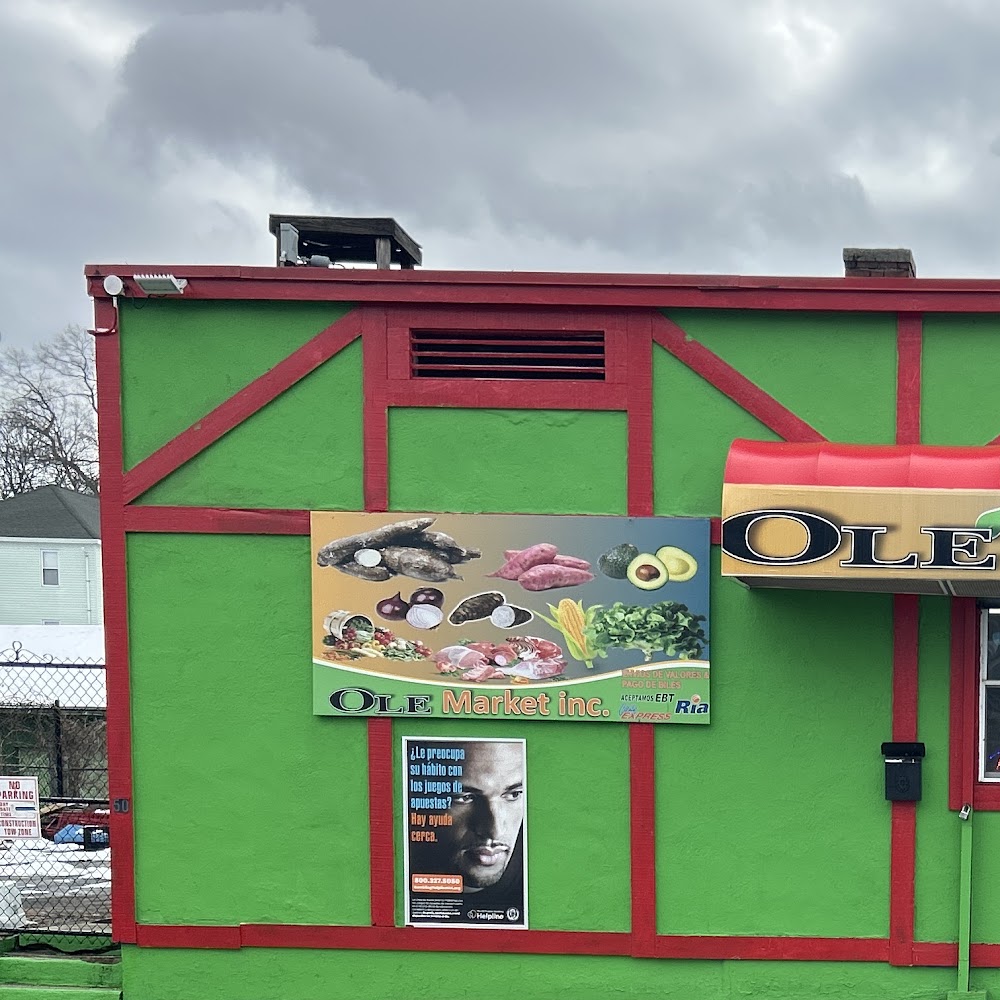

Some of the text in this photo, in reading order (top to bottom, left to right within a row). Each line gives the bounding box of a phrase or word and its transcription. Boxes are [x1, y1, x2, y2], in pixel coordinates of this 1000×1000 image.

[653, 671, 664, 679] DE
[666, 671, 702, 679] VALORES
[622, 681, 682, 690] PAGO DE BILES
[442, 689, 550, 716] Market
[558, 691, 611, 717] inc.
[621, 693, 675, 703] ACEPTAMOS EBT
[675, 694, 709, 714] Ria
[621, 712, 671, 720] EXPRESS
[410, 746, 465, 761] ¿Le preocupa
[410, 761, 463, 776] su hábito con
[9, 781, 20, 789] NO
[410, 779, 463, 794] los juegos de
[0, 791, 34, 799] ARKING
[410, 796, 452, 810] apuestas?
[411, 812, 453, 827] Hay ayuda
[411, 831, 438, 842] cerca.
[476, 912, 504, 921] Helpline
